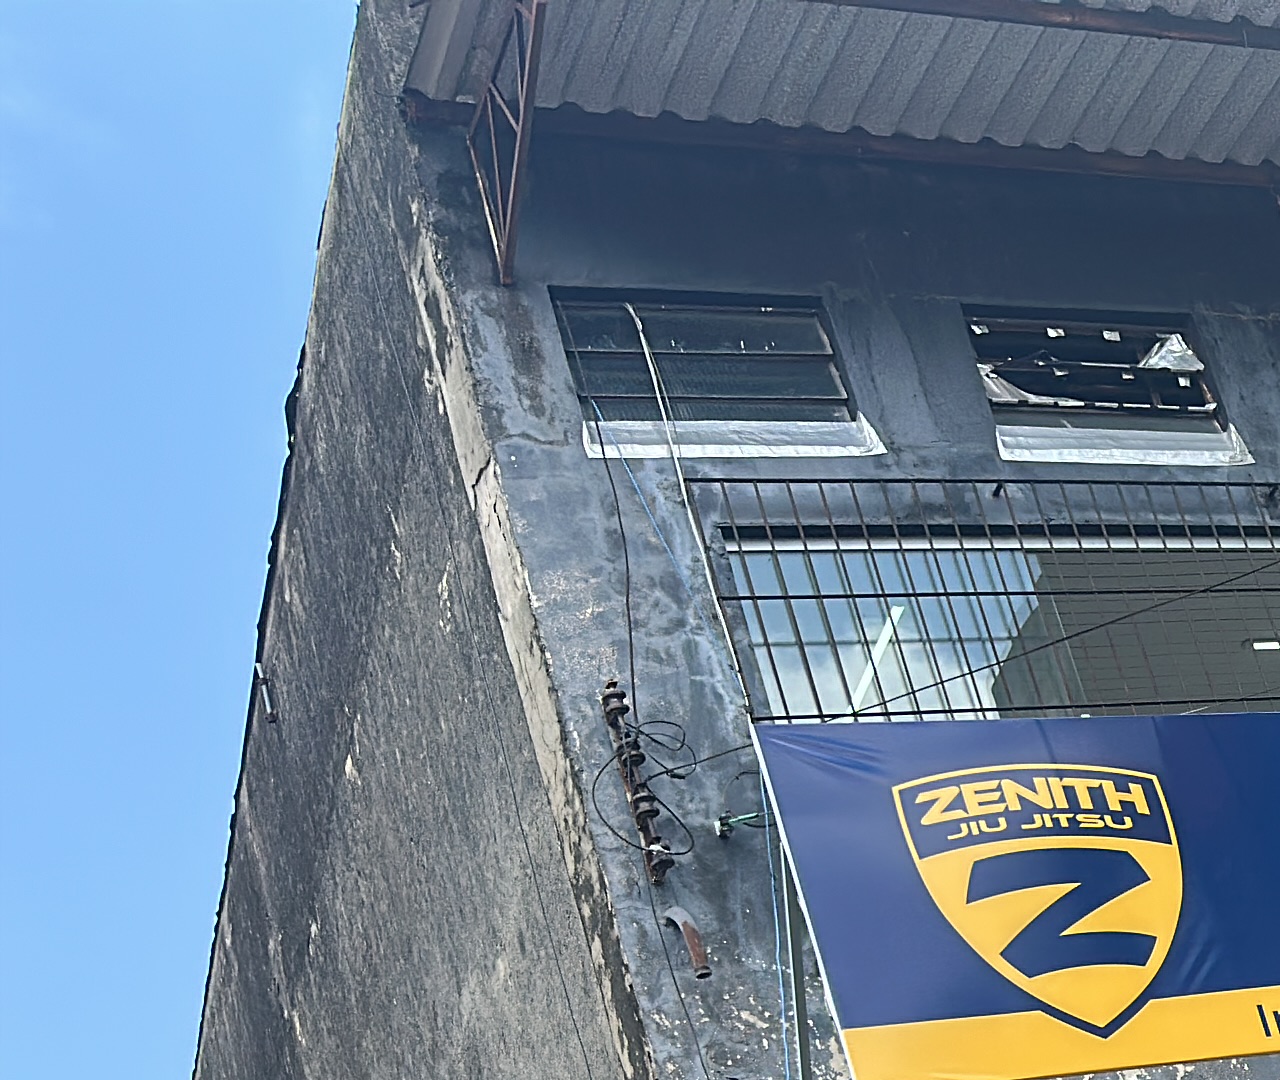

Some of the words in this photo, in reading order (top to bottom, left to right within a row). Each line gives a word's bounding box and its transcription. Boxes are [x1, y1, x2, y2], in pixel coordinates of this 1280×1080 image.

[914, 776, 1152, 828] ZENITH
[947, 815, 1008, 841] JIU
[1020, 812, 1133, 832] JITSU
[966, 847, 1158, 979] Z
